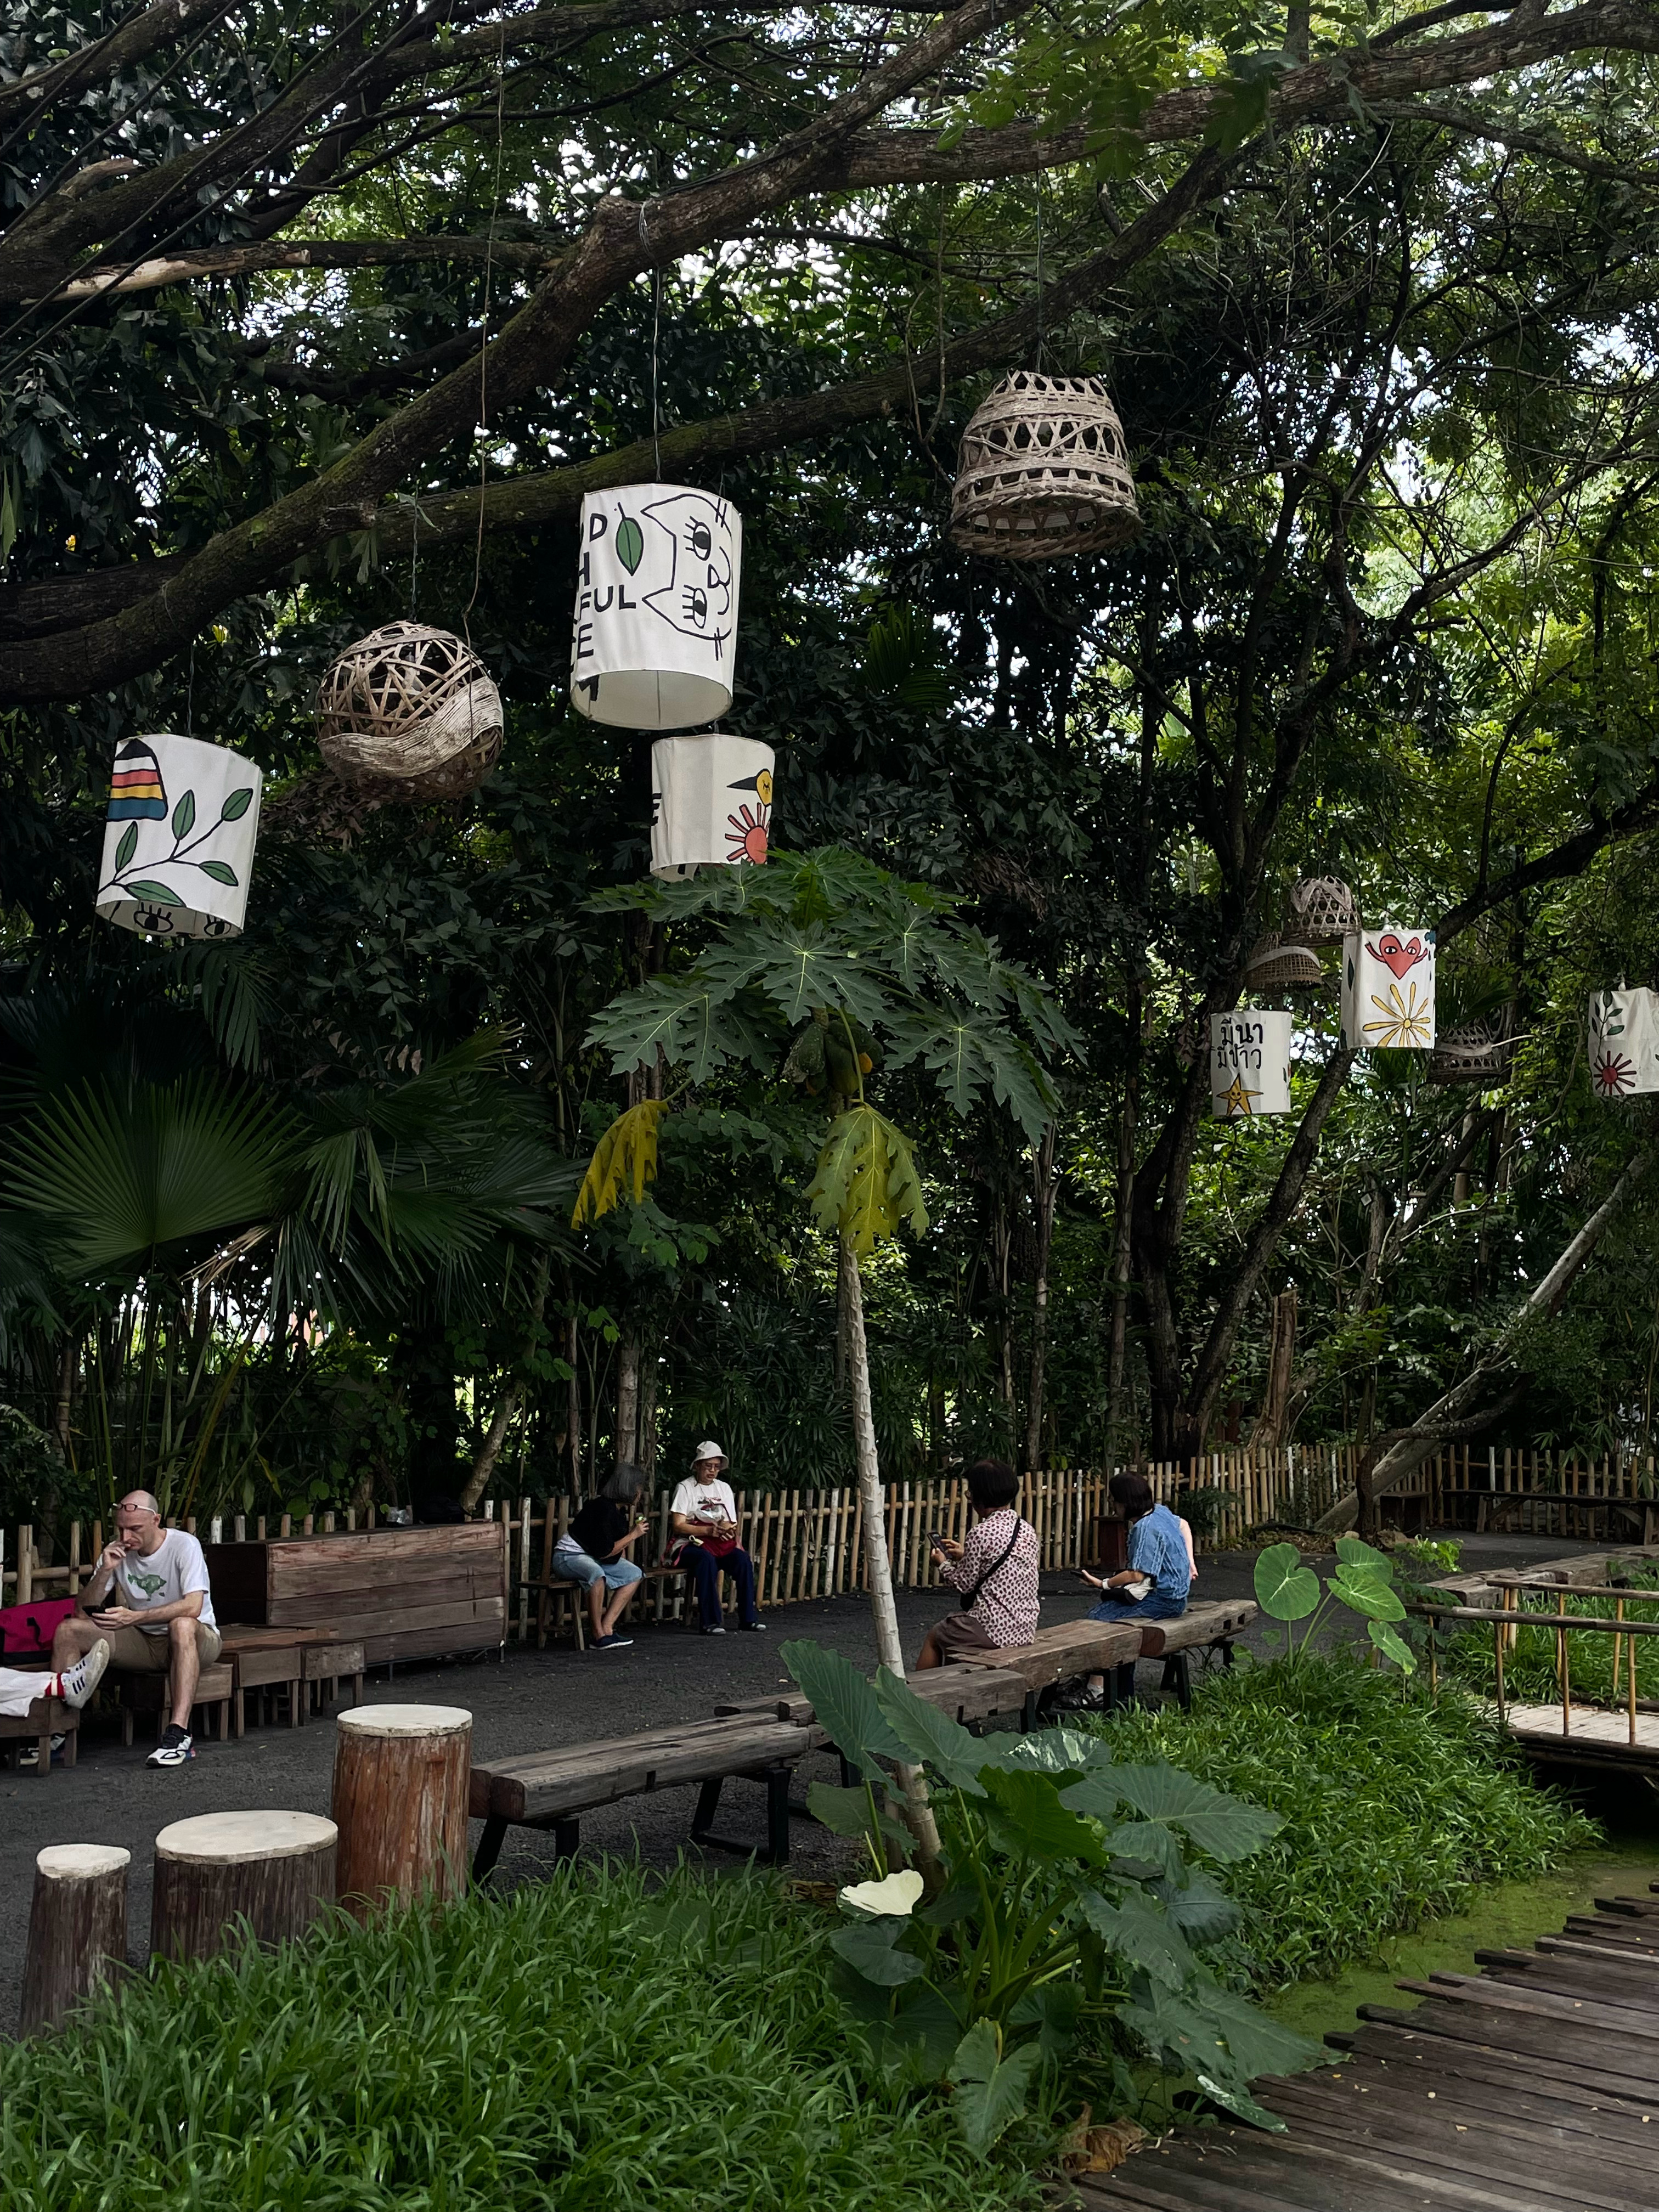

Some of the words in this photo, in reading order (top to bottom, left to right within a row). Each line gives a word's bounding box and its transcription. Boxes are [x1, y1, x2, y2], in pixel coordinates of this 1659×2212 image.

[580, 513, 607, 542] D
[572, 618, 594, 659] E
[1221, 1017, 1263, 1046] มีนา
